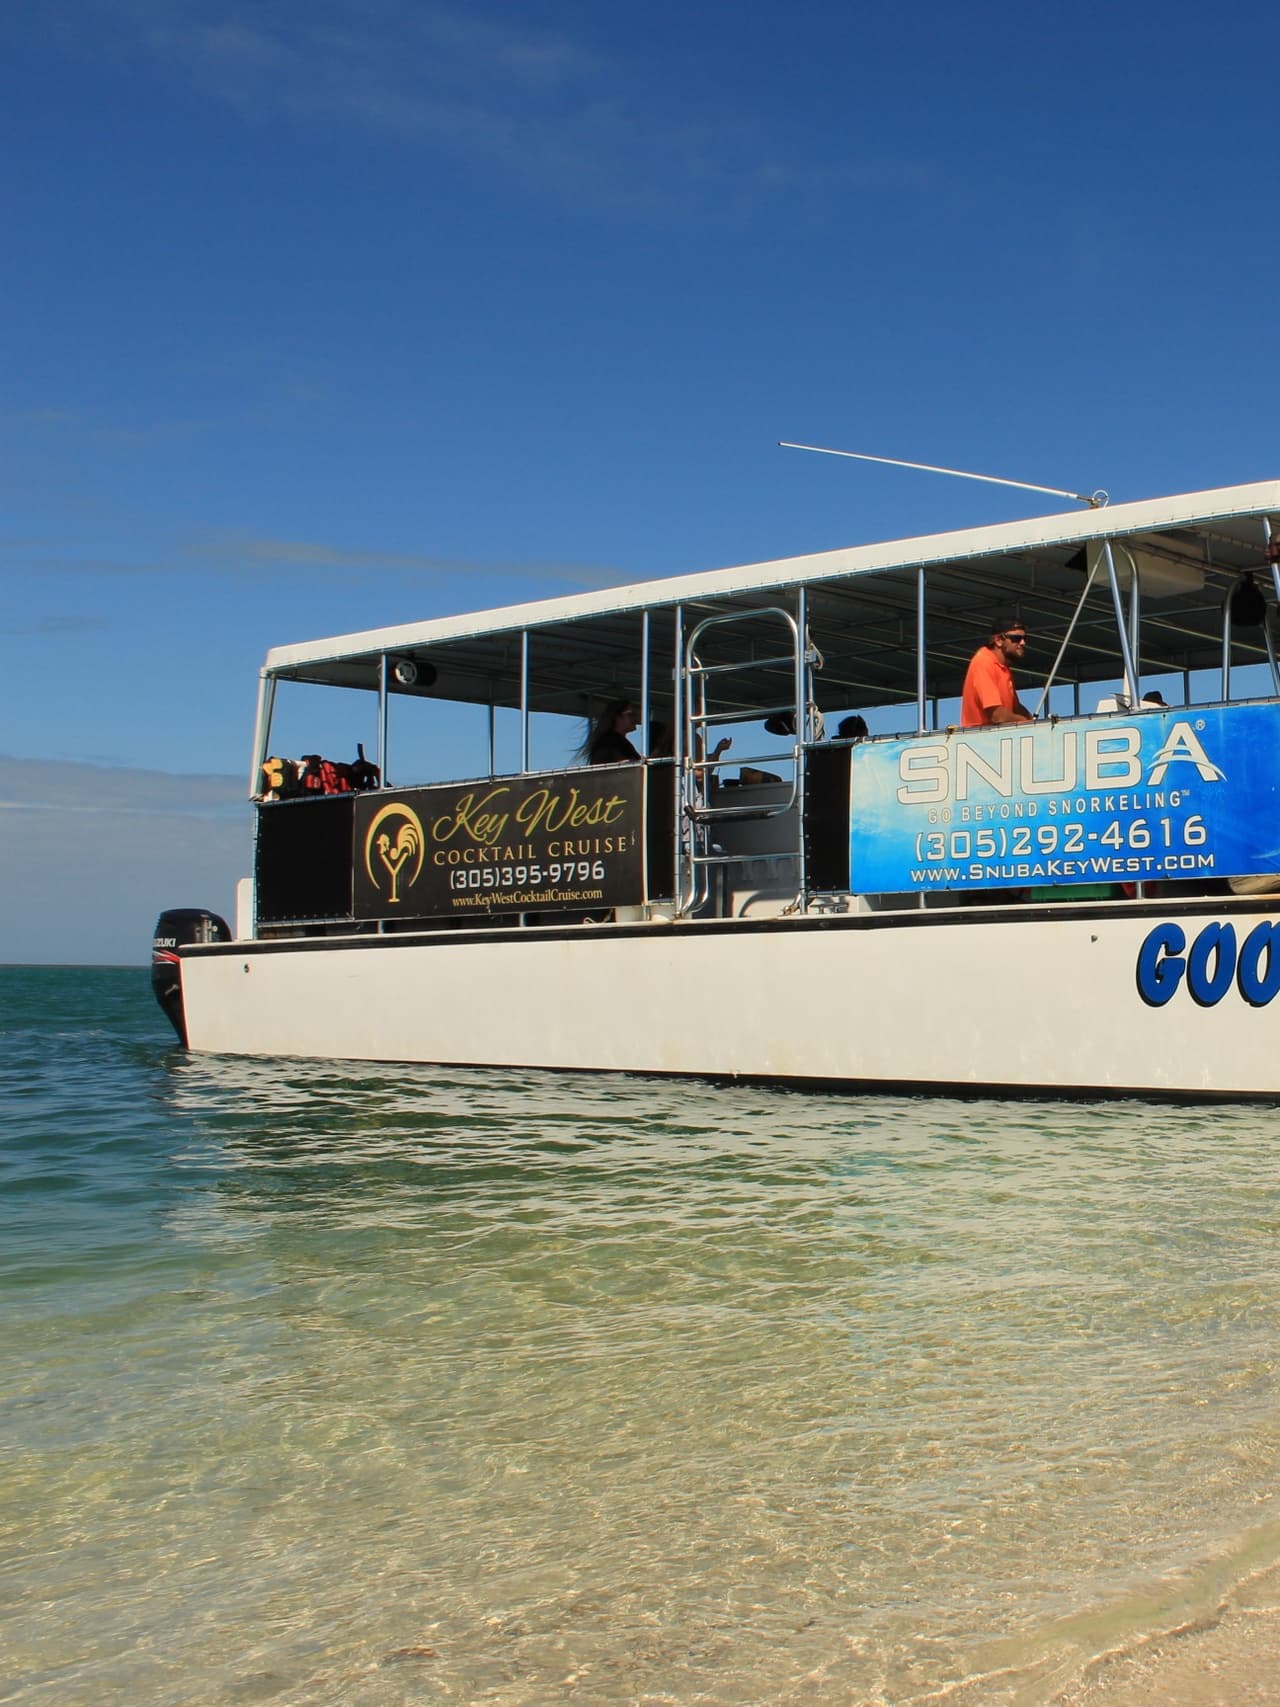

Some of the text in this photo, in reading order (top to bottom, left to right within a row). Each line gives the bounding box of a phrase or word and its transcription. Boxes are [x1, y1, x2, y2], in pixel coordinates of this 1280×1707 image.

[897, 721, 1226, 805] SNUBA
[432, 787, 627, 844] Key West
[927, 807, 953, 824] GO
[962, 804, 1038, 823] BEYOND
[433, 837, 627, 866] COCKTAIL CRUISE
[915, 815, 1208, 862] (305)292-4616
[450, 860, 605, 890] (305)395-9796
[452, 889, 603, 907] www.KeyWestCocktailCruise.com
